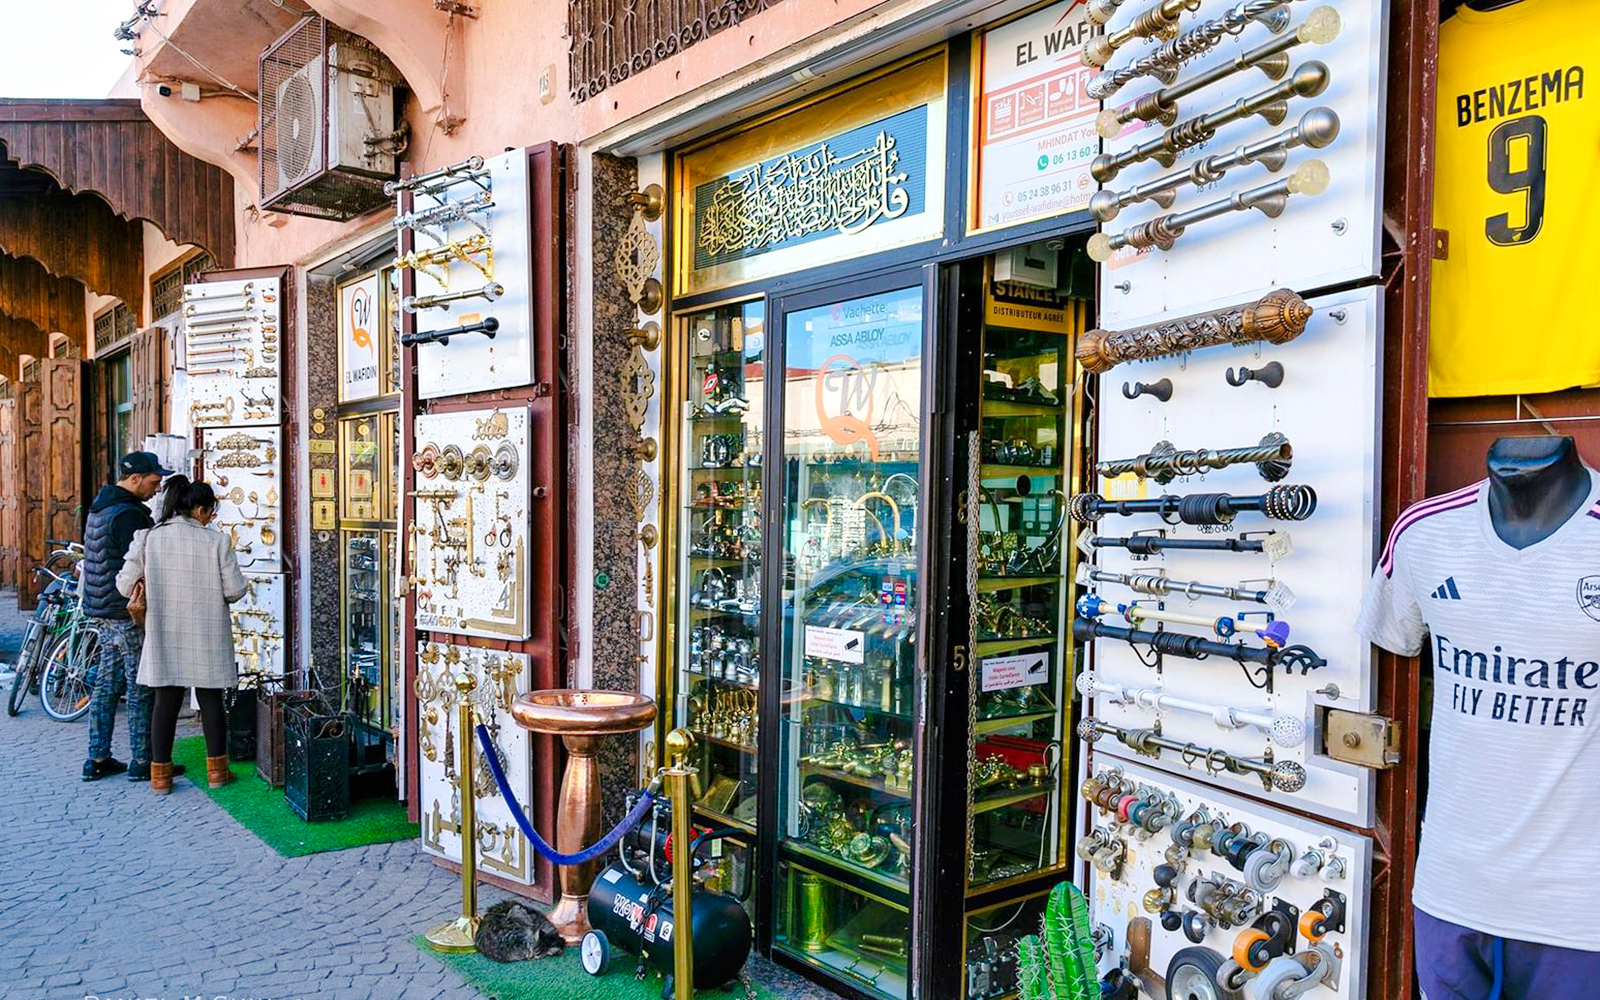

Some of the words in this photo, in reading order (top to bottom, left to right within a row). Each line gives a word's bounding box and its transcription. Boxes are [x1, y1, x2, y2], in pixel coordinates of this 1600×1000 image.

[1016, 40, 1038, 67] EL
[1456, 65, 1584, 127] BENZEMA
[1037, 131, 1079, 151] MHINDAT
[1052, 154, 1064, 165] 06
[1066, 150, 1077, 161] 13
[1079, 146, 1091, 158] 60
[1017, 191, 1028, 202] 05
[1028, 188, 1039, 200] 24
[1039, 186, 1050, 198] 38
[1051, 183, 1062, 195] 96
[1062, 180, 1072, 192] 31
[1485, 115, 1548, 247] 9
[842, 302, 886, 319] Vachette
[993, 306, 1042, 320] DISTRIBUTEUR
[830, 333, 853, 347] ASSA
[854, 327, 885, 344] ABLOY
[953, 646, 965, 671] 5
[1435, 634, 1599, 689] Emirate
[1453, 683, 1483, 716] FLY
[1491, 692, 1588, 726] BETTER
